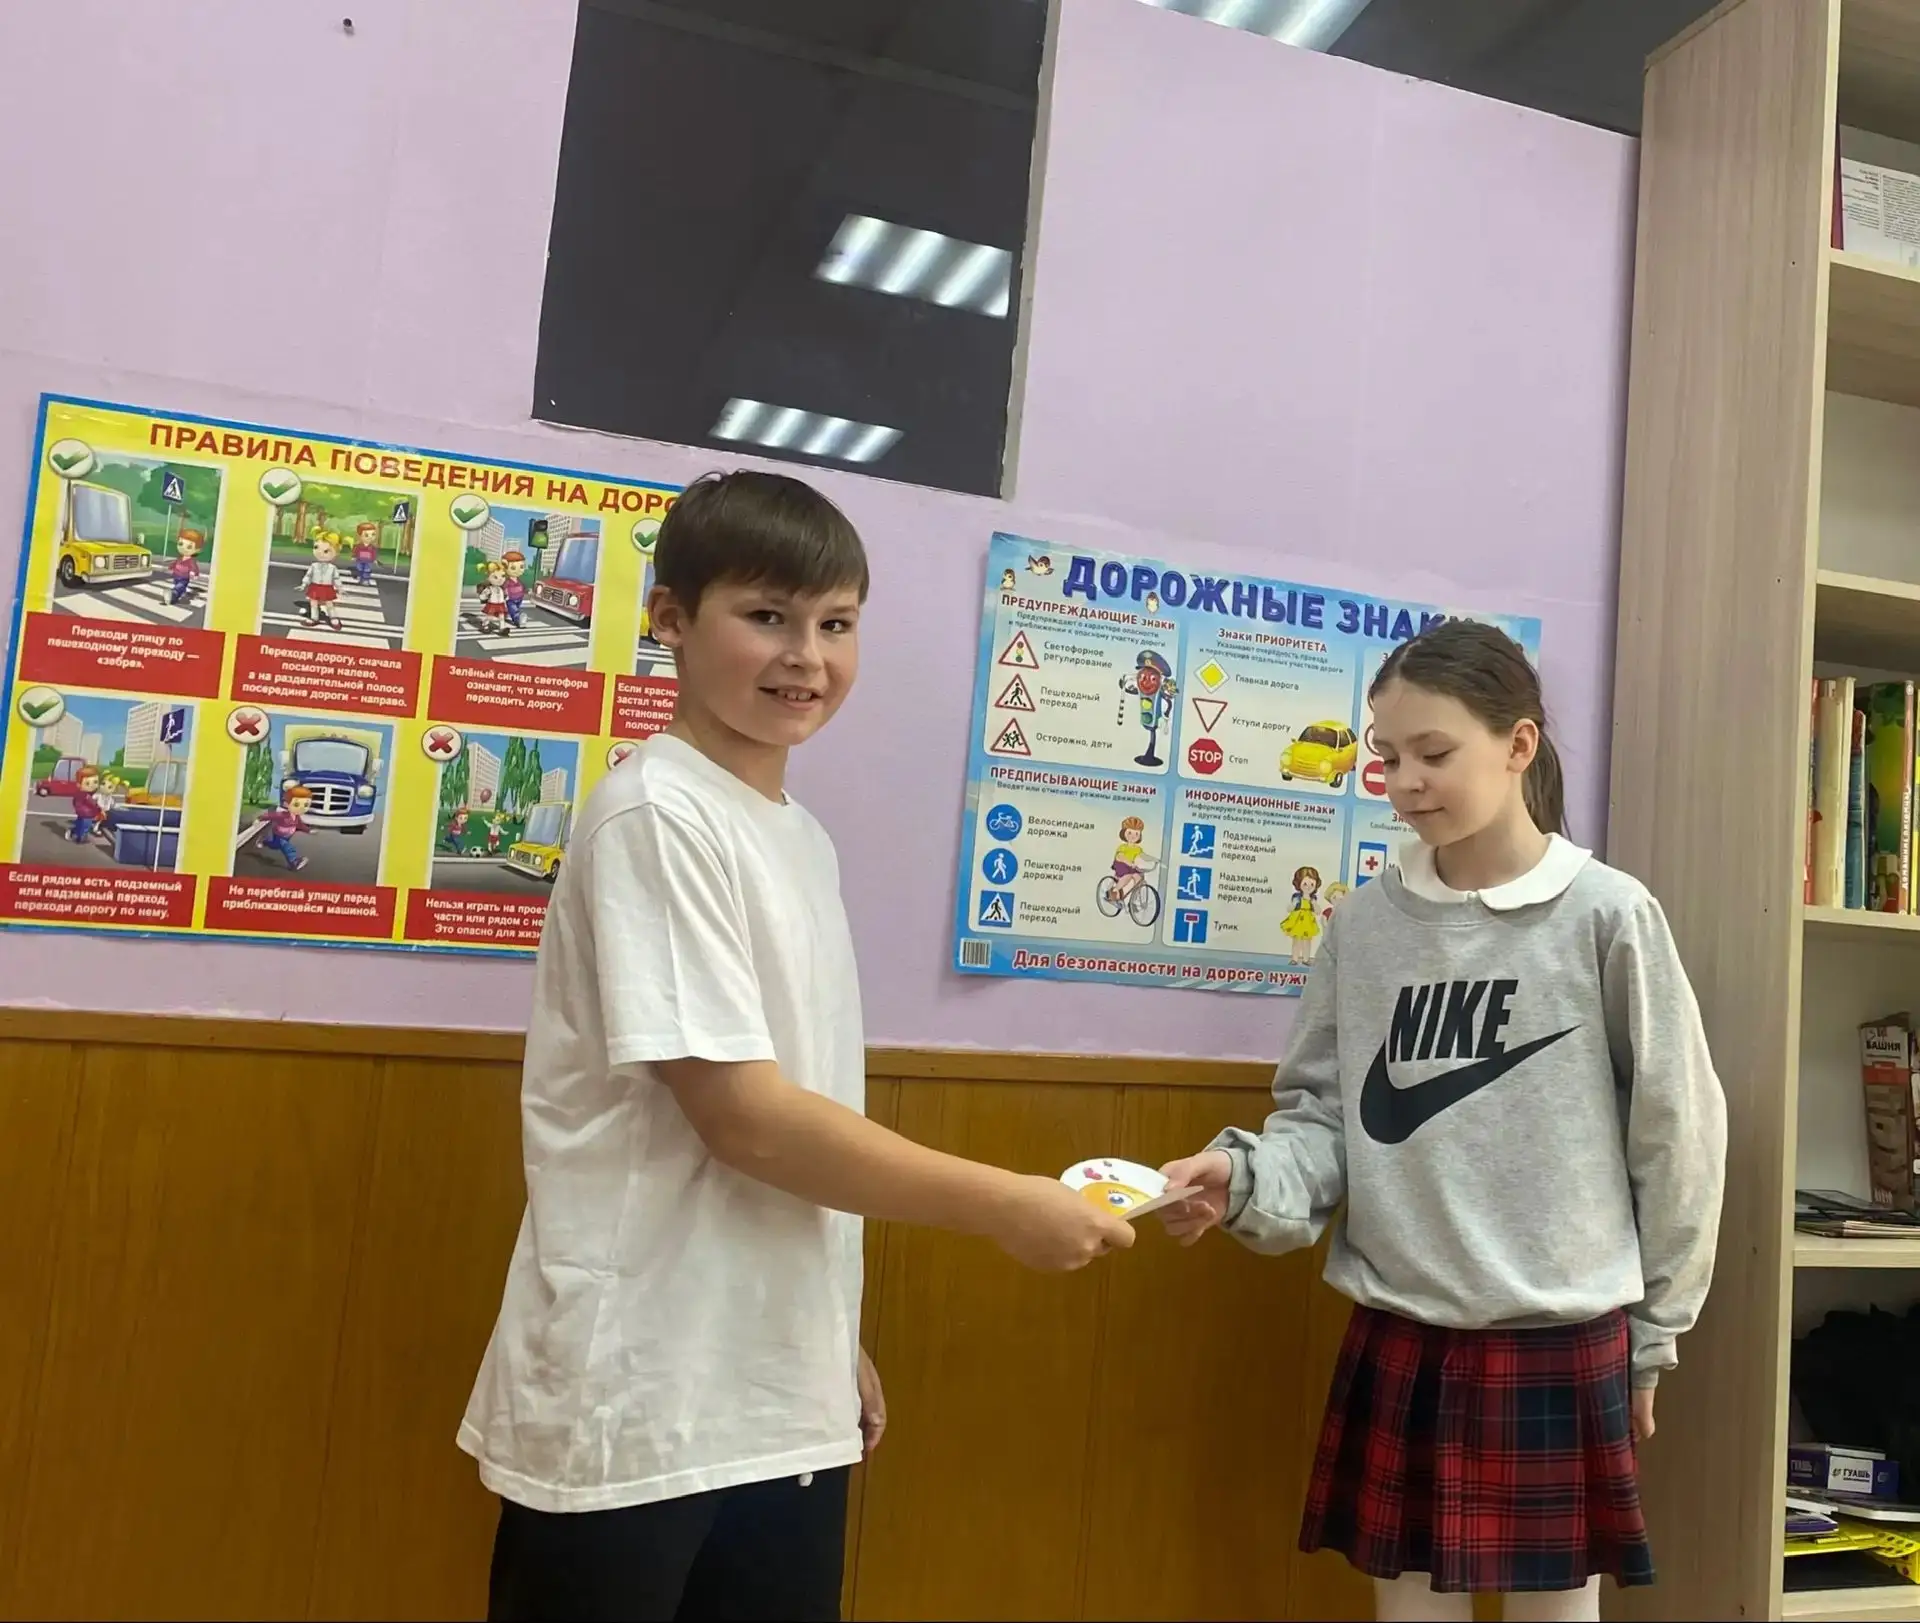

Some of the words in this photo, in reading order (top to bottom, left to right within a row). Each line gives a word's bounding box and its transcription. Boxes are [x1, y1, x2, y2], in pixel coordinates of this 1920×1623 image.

[150, 424, 317, 468] ПРАВИЛА
[330, 449, 535, 498] ПОВЕДЕНИЯ
[546, 479, 589, 506] НА
[1062, 555, 1326, 630] ДОРОЖНЫЕ
[1336, 598, 1473, 642] ЗНАК
[1001, 594, 1138, 625] ПРЕДУПРЕЖДАЮЩИЕ
[1141, 617, 1175, 631] знаки
[1016, 611, 1077, 628] Предупреждают
[1083, 622, 1122, 633] характере
[1122, 627, 1159, 638] опасности
[71, 625, 128, 641] Переходи
[130, 632, 165, 645] улицу
[168, 637, 183, 646] по
[1074, 629, 1109, 641] опасному
[1111, 634, 1139, 645] участку
[1218, 628, 1252, 641] Знаки
[1255, 633, 1328, 653] ПРИОРИТЕТА
[47, 638, 128, 655] пешеходному
[131, 647, 185, 661] переходу
[1043, 641, 1104, 657] Светофорное
[1216, 640, 1255, 651] Указывают
[260, 644, 313, 661] Переходя
[315, 651, 356, 665] дорогу,
[358, 657, 402, 669] сначала
[1043, 652, 1112, 668] регулирование
[281, 661, 334, 676] посмотри
[337, 667, 378, 680] налево,
[449, 665, 495, 680] Зелёный
[497, 672, 532, 684] сигнал
[534, 675, 588, 689] светофора
[248, 672, 255, 680] а
[258, 672, 272, 681] на
[274, 674, 363, 690] разделительной
[366, 683, 404, 694] полосе
[466, 681, 514, 694] означает,
[516, 686, 533, 696] что
[536, 688, 570, 699] можно
[618, 682, 642, 693] Если
[1235, 674, 1269, 686] Главная
[1270, 680, 1299, 691] дорога
[242, 683, 308, 697] посередине
[310, 690, 348, 702] дороги
[361, 695, 407, 708] направо.
[466, 692, 525, 707] переходить
[527, 699, 564, 712] дорогу.
[616, 695, 650, 706] застал
[652, 698, 674, 708] тебя
[1040, 686, 1100, 702] Пешеходный
[1039, 697, 1078, 711] переход
[625, 721, 660, 731] полосе
[1231, 716, 1261, 729] Уступи
[1262, 722, 1291, 733] дорогу
[1036, 732, 1088, 747] Осторожно,
[1090, 739, 1113, 750] дети
[1189, 749, 1222, 764] STOP
[1228, 754, 1249, 765] Стоп
[990, 766, 1119, 791] ПРЕДПИСЫВАЮЩИЕ
[1122, 784, 1156, 796] знаки
[997, 781, 1024, 791] Вводят
[1080, 790, 1111, 800] режимы
[1185, 789, 1301, 811] ИНФОРМАЦИОННЫЕ
[1303, 804, 1336, 816] знаки
[1188, 802, 1236, 814] Информируют
[1027, 816, 1095, 831] Велосипедная
[1198, 812, 1221, 821] других
[1027, 827, 1068, 839] дорожка
[1223, 830, 1272, 843] Подземный
[1222, 842, 1276, 854] пешеходный
[1221, 852, 1256, 862] переход
[1023, 859, 1082, 872] Пешеходная
[8, 871, 39, 883] Если
[42, 875, 81, 887] рядом
[84, 878, 110, 887] есть
[114, 879, 182, 892] подземный
[1022, 871, 1063, 882] дорожка
[1219, 871, 1269, 884] Надземный
[18, 887, 42, 896] или
[45, 889, 113, 901] надземный
[117, 893, 168, 906] переход,
[228, 885, 244, 896] Не
[247, 887, 305, 900] перебегай
[307, 892, 340, 904] улицу
[343, 894, 377, 906] перед
[1218, 883, 1273, 895] пешеходный
[425, 898, 464, 910] Нельзя
[466, 902, 500, 913] играть
[502, 904, 515, 913] на
[1217, 893, 1253, 904] переход
[14, 900, 71, 913] переходи
[74, 904, 117, 917] дорогу
[120, 907, 135, 916] по
[138, 908, 170, 920] нему.
[222, 899, 323, 914] приближающейся
[326, 905, 379, 917] машиной.
[1019, 901, 1081, 915] Пешеходный
[433, 912, 463, 923] части
[466, 913, 485, 924] или
[488, 915, 520, 928] рядом
[522, 918, 530, 926] с
[1019, 913, 1058, 924] переход
[1213, 921, 1239, 932] Тупик
[434, 924, 454, 935] Это
[456, 925, 493, 937] опасно
[495, 928, 515, 938] для
[1013, 950, 1050, 968] Для
[1056, 953, 1176, 976] безопасности
[1182, 964, 1201, 978] на
[1206, 966, 1264, 982] дороге
[1389, 979, 1519, 1063] NIKE
[1843, 1468, 1871, 1478] ГУАШЬ
